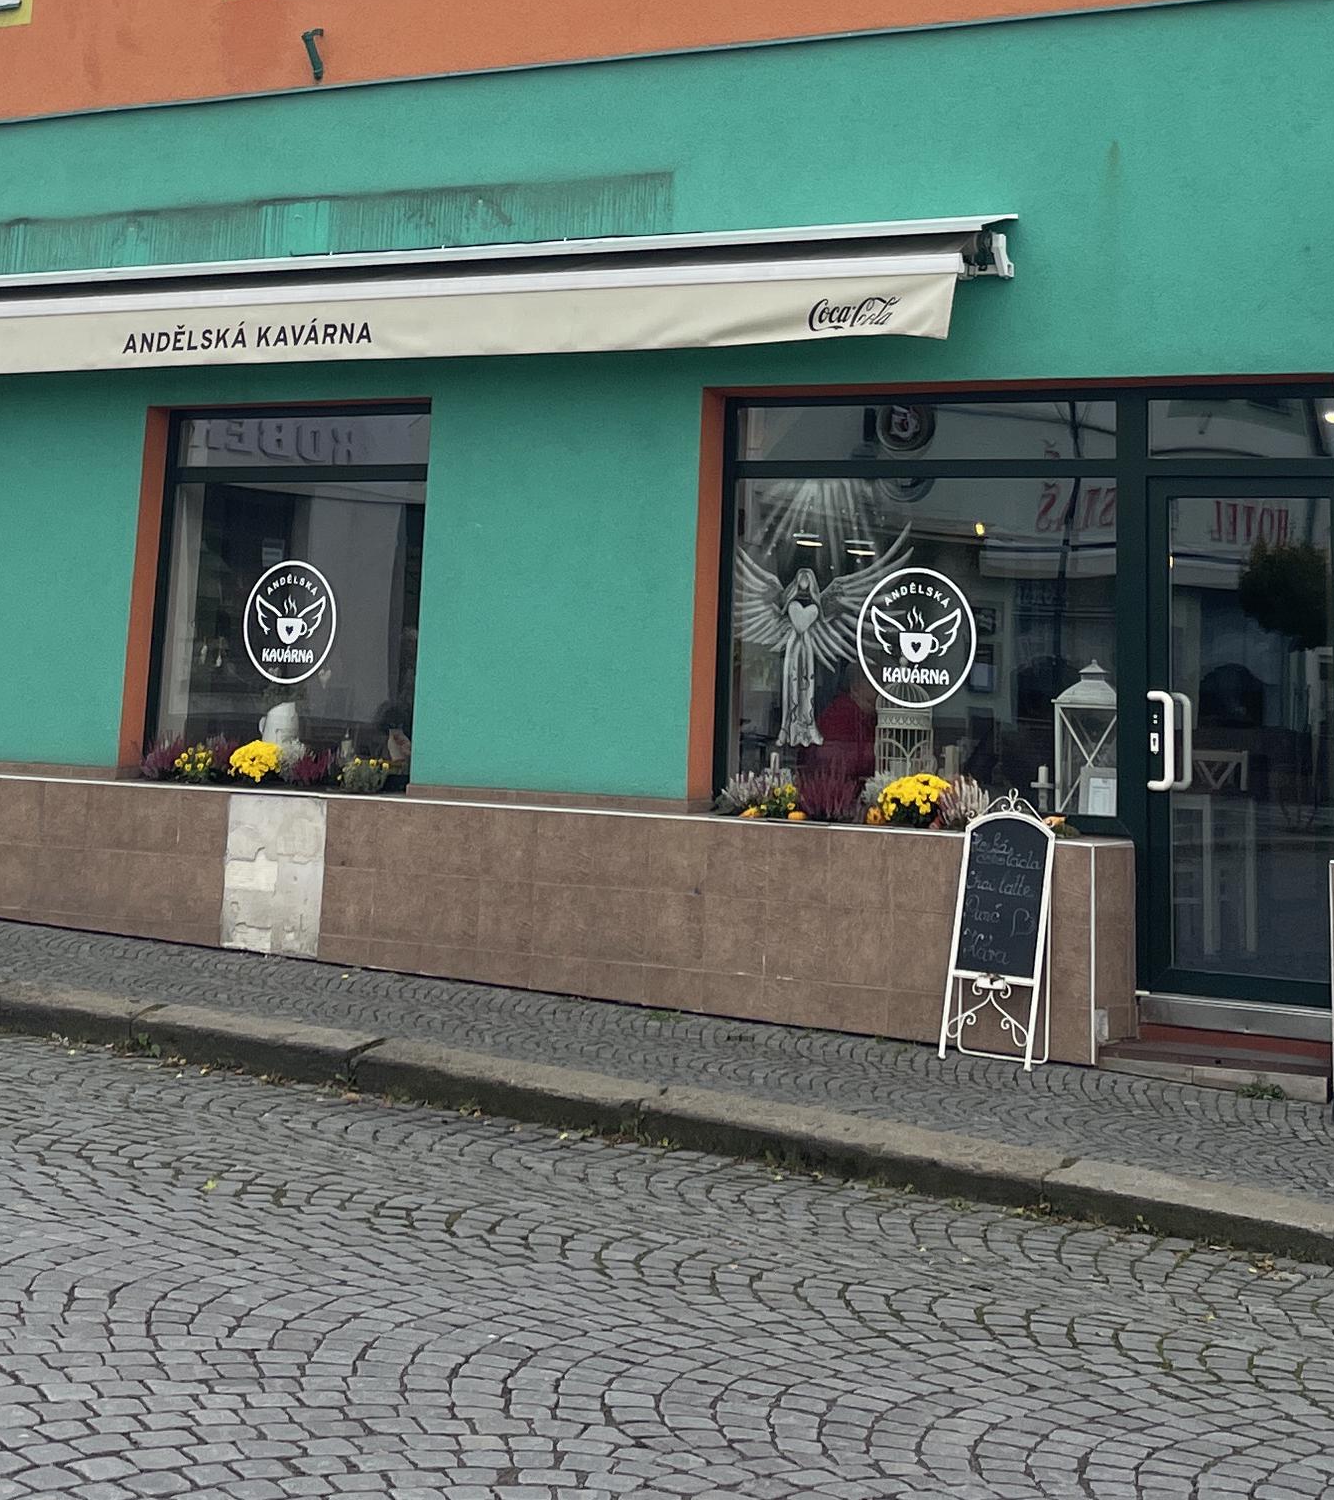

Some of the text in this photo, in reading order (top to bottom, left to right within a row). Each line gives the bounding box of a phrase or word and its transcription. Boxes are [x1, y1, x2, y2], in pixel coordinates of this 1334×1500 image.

[122, 317, 373, 354] ANDĚLSKÁ KAVÁRNA
[261, 646, 314, 664] KAVÁRNA
[882, 664, 950, 686] KAVÁRNA
